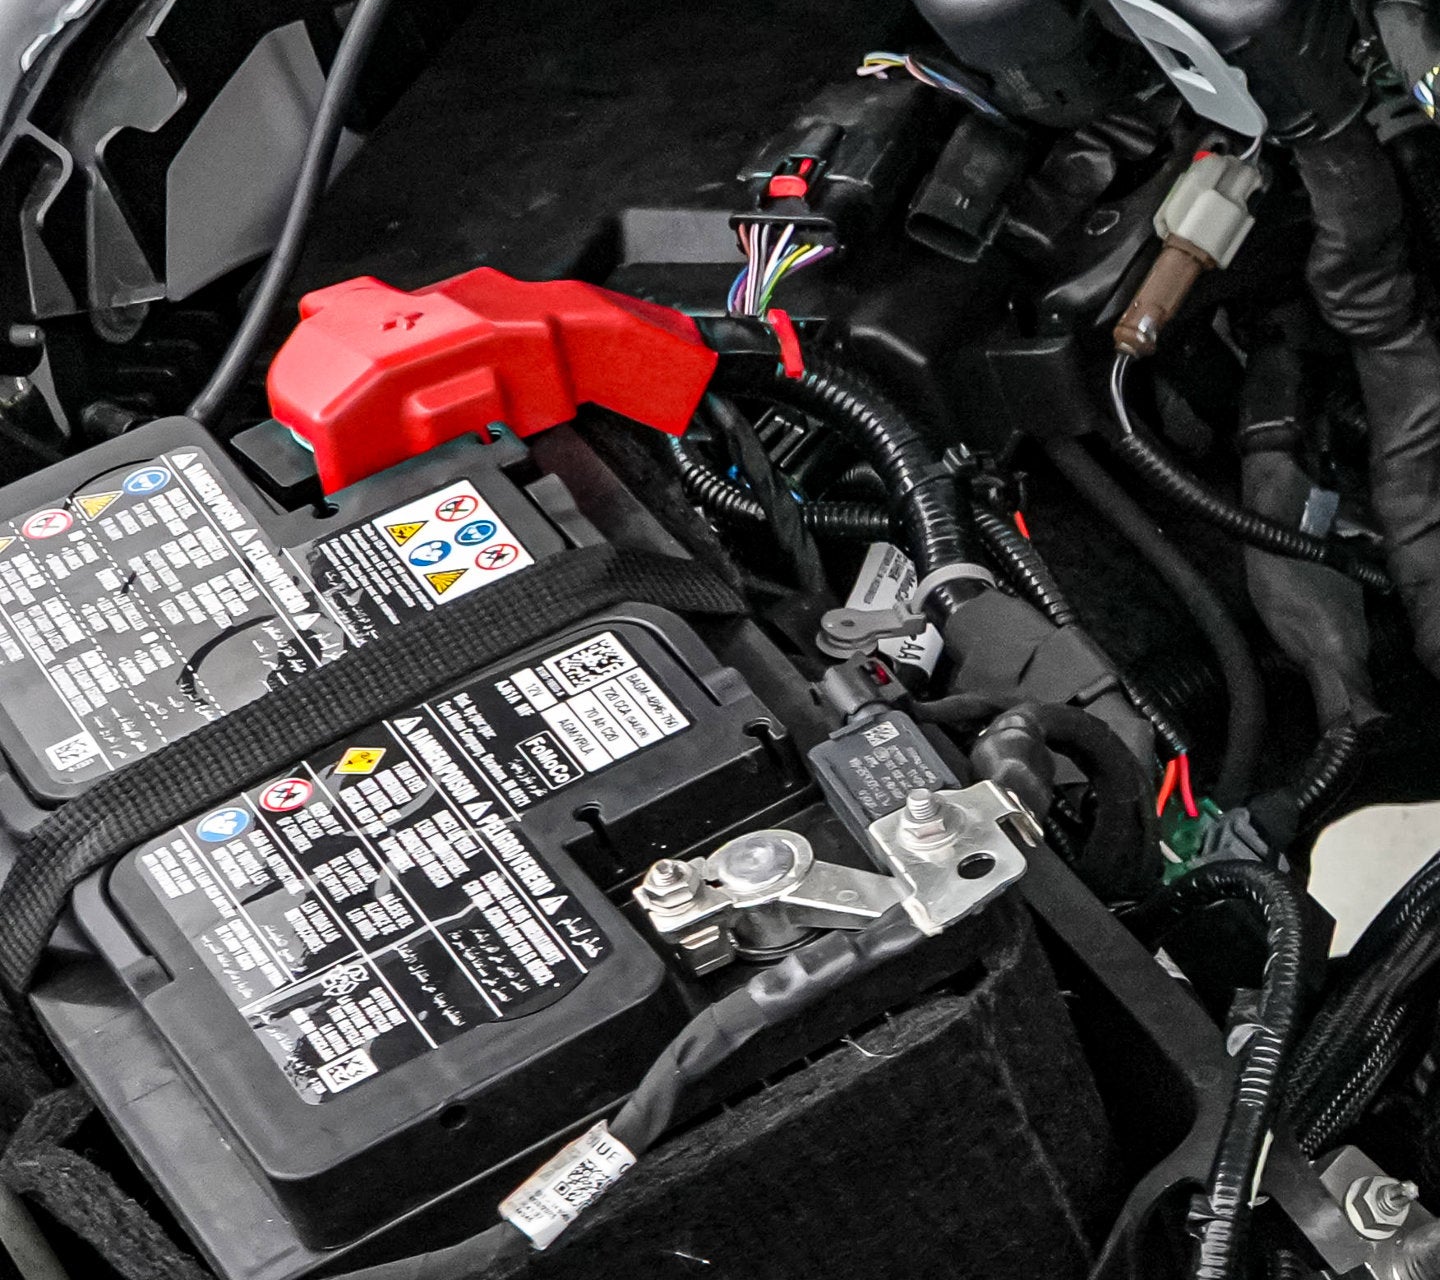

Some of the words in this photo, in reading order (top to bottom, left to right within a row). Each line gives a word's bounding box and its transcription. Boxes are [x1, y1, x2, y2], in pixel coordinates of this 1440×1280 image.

[524, 682, 544, 698] 12V
[584, 707, 599, 718] 70
[612, 699, 632, 716] CCA
[591, 716, 608, 729] Ah
[556, 717, 596, 756] AGM/VRLA
[599, 726, 619, 742] C20
[404, 725, 482, 805] DANGER/POISON
[522, 735, 576, 785] FoMoCo
[472, 811, 558, 899] PELIGRO/VENENO
